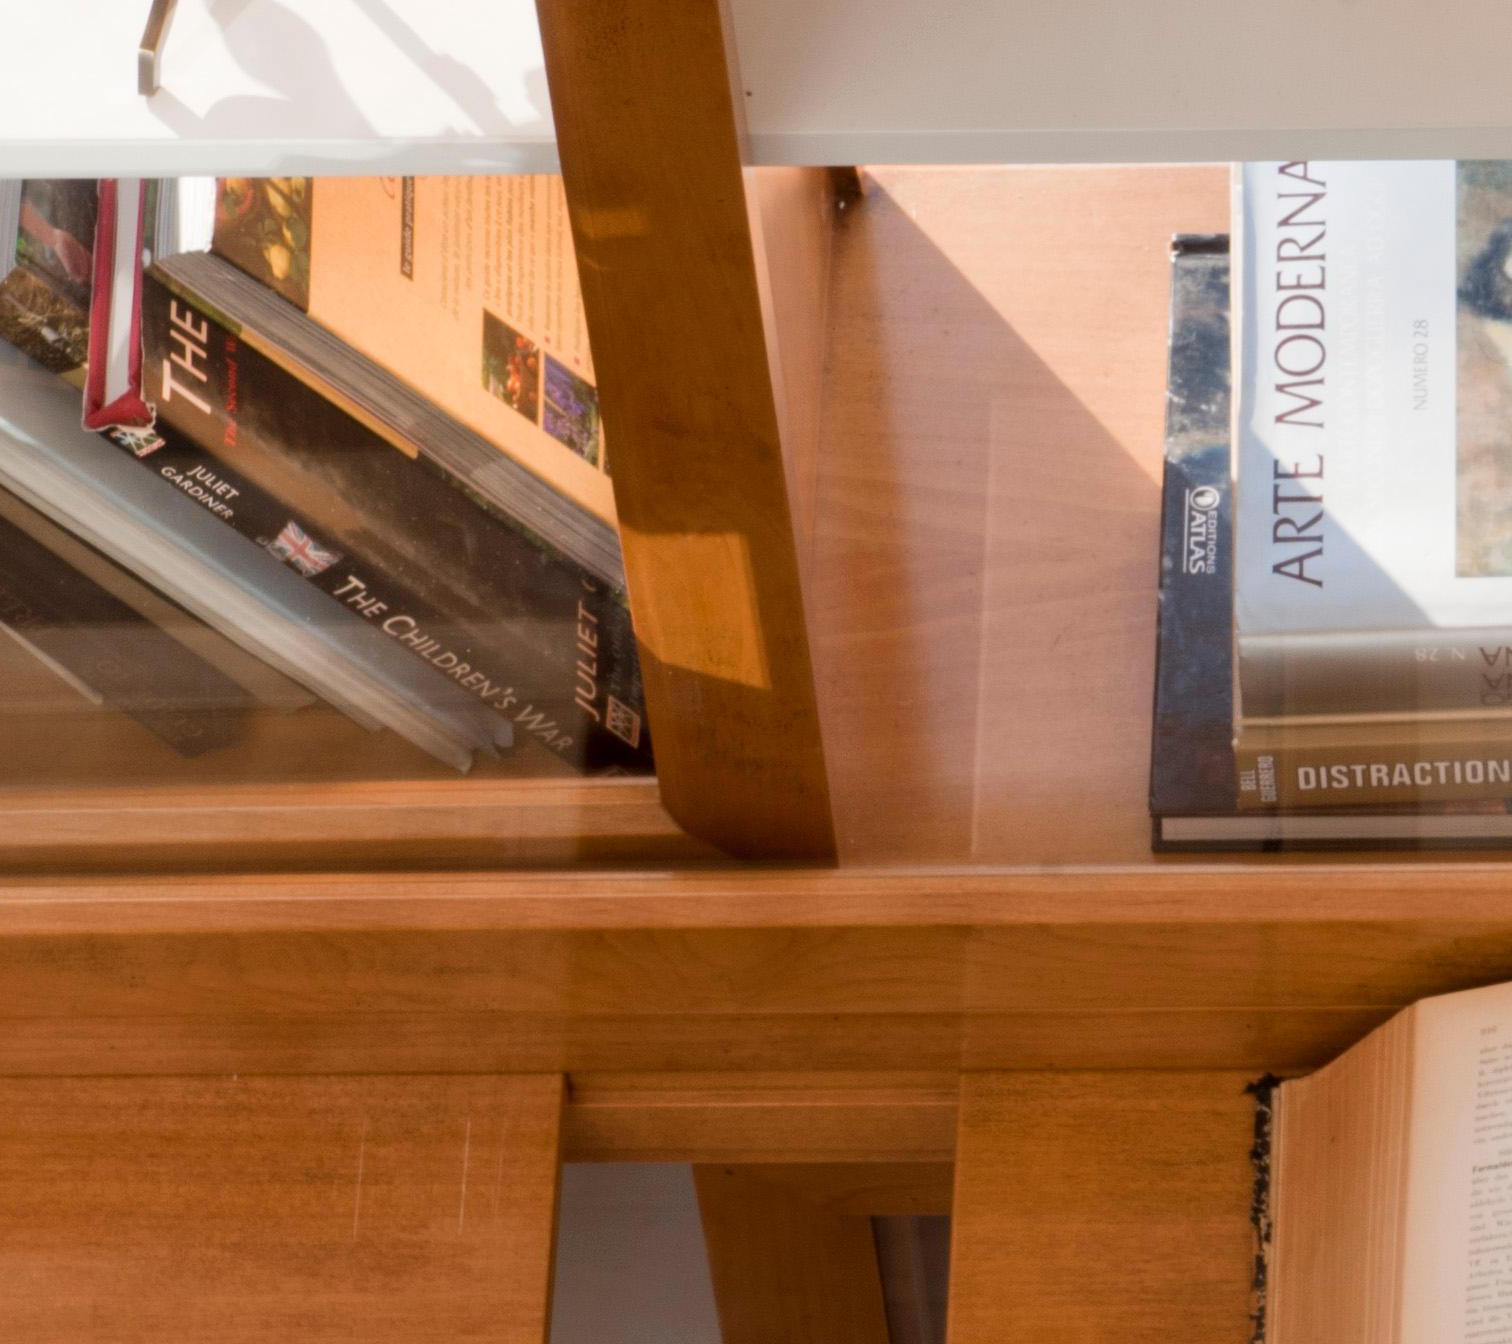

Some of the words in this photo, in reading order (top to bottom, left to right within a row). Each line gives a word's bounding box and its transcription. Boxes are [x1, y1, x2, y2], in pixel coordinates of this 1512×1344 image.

[1273, 160, 1328, 429] MODERNA
[161, 299, 212, 416] THE
[1413, 318, 1429, 339] 28
[1412, 342, 1429, 413] NUMERO
[159, 464, 236, 521] GARDINER
[188, 462, 241, 502] JULIET
[1187, 511, 1207, 576] ATLAS
[1205, 511, 1217, 575] EDITIONS
[1271, 453, 1325, 589] ARTE
[331, 574, 387, 623] THE
[380, 614, 521, 712] CHILDREN'S
[513, 703, 575, 755] WAR
[573, 600, 600, 722] JULIET
[1239, 768, 1257, 791] BELL
[1297, 759, 1511, 790] DISTRACTION
